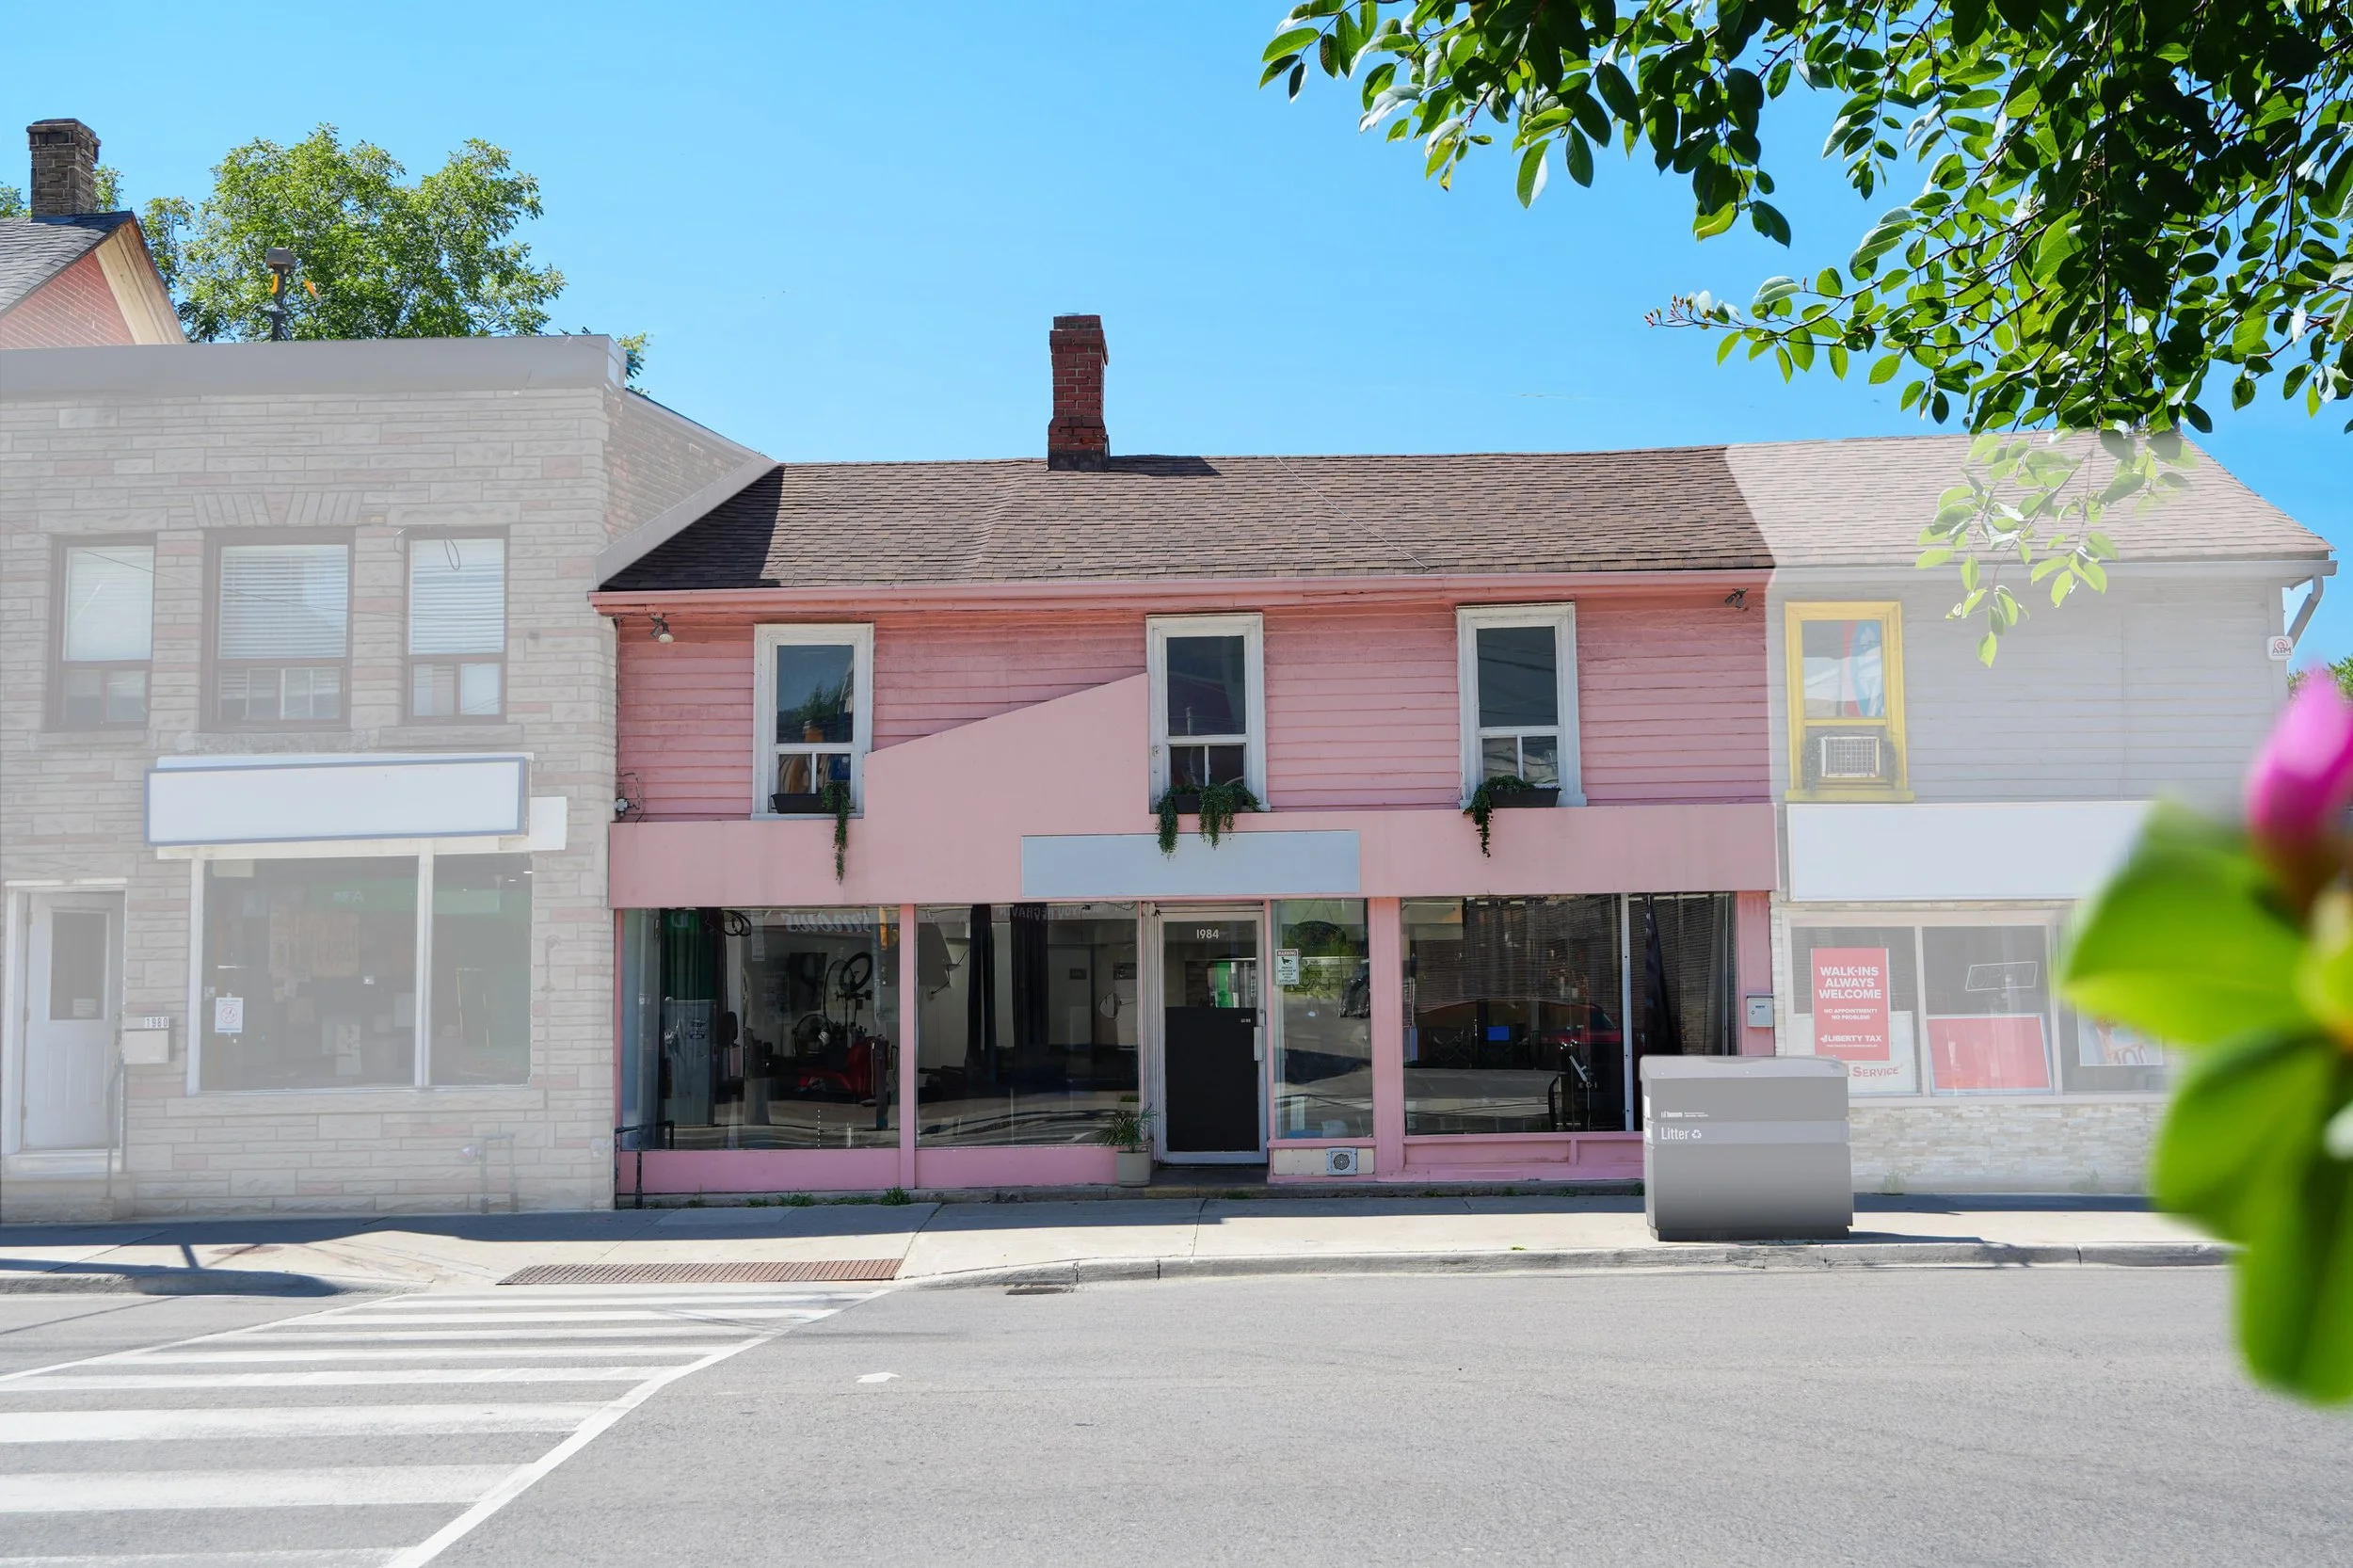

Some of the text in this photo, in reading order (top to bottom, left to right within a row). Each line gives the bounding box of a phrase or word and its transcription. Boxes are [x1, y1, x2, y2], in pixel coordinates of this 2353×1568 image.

[1196, 929, 1220, 939] 1984
[1819, 967, 1880, 976] WALK-INS
[1825, 978, 1875, 987] ALWAYS
[1818, 989, 1881, 1000] WELCOME
[146, 1017, 168, 1028] 1980
[1852, 1065, 1899, 1078] SERVICE
[1661, 1127, 1689, 1140] Litter
